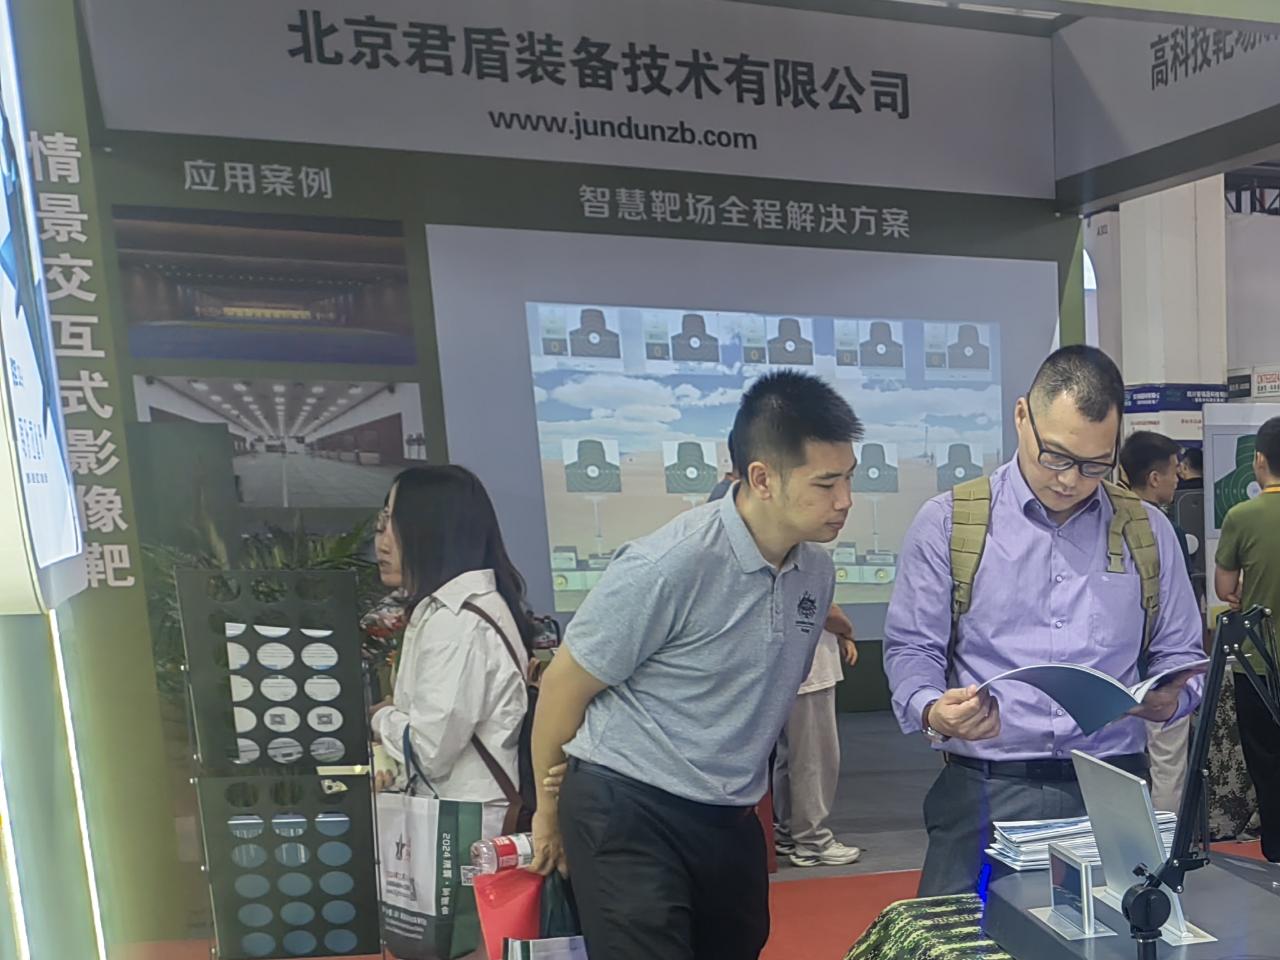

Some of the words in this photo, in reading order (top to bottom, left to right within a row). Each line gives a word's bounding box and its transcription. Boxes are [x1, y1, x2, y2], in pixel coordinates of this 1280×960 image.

[287, 9, 911, 119] 北京君盾装备技术有限公司
[488, 110, 758, 151] www.jundunzb.com
[183, 158, 333, 199] 应用案例
[579, 184, 911, 238] 智慧靶场全程解决方案
[28, 131, 136, 589] 情景交互式影像靶
